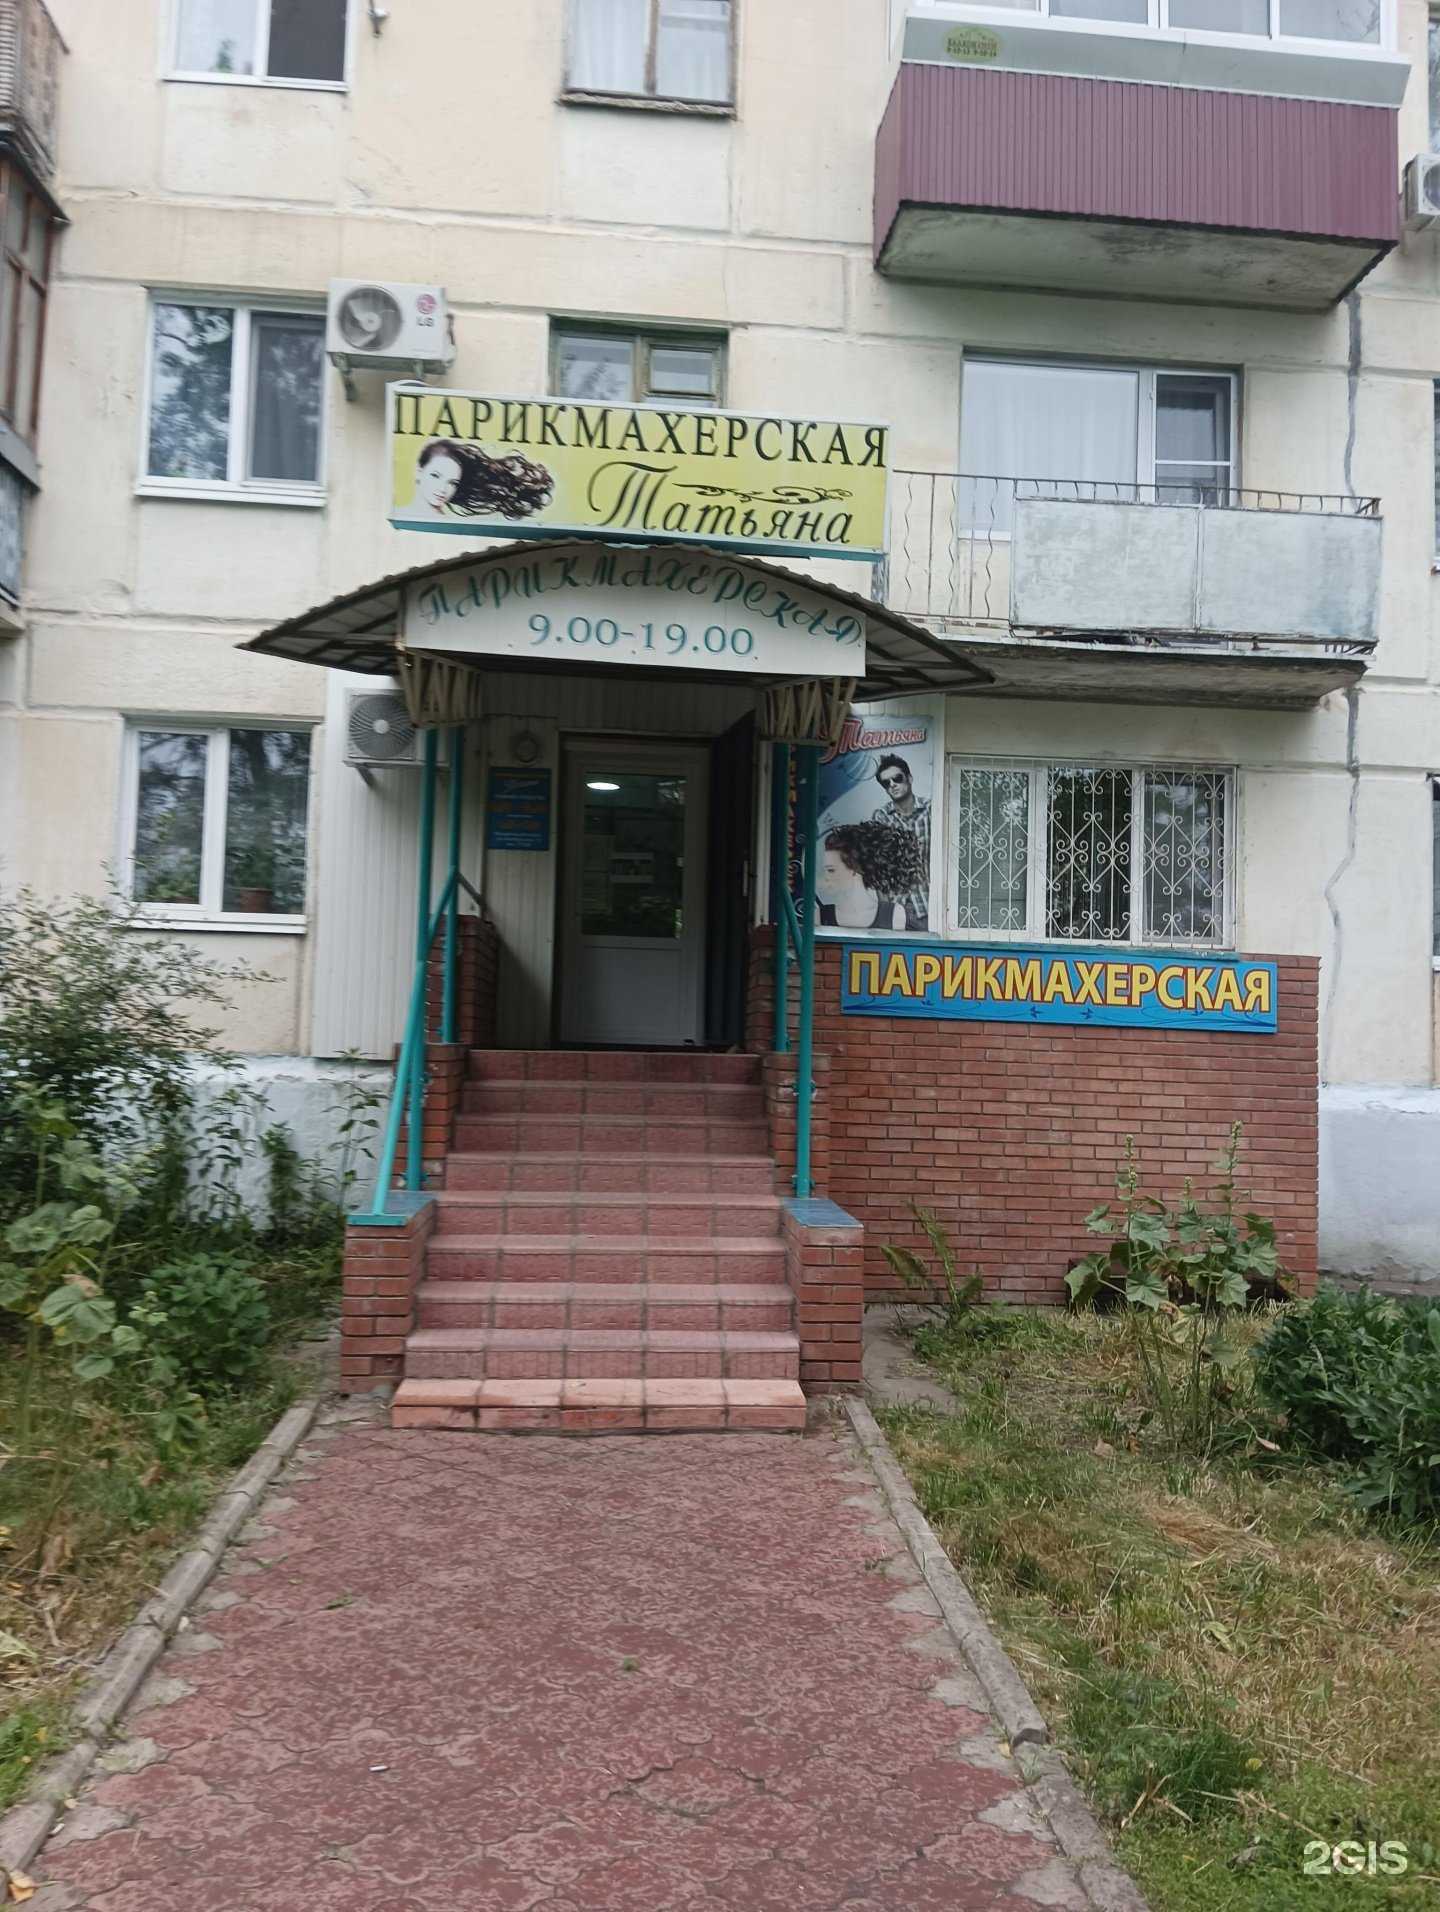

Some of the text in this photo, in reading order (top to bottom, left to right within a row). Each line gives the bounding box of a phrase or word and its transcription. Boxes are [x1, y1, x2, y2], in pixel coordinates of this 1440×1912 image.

[393, 393, 888, 469] ПАРИКМАХЕРСКАЯ
[587, 460, 854, 544] Татьяна
[528, 614, 755, 656] 9.00-19.00
[848, 951, 1271, 1013] ПАРИКМАХЕРСКАЯ
